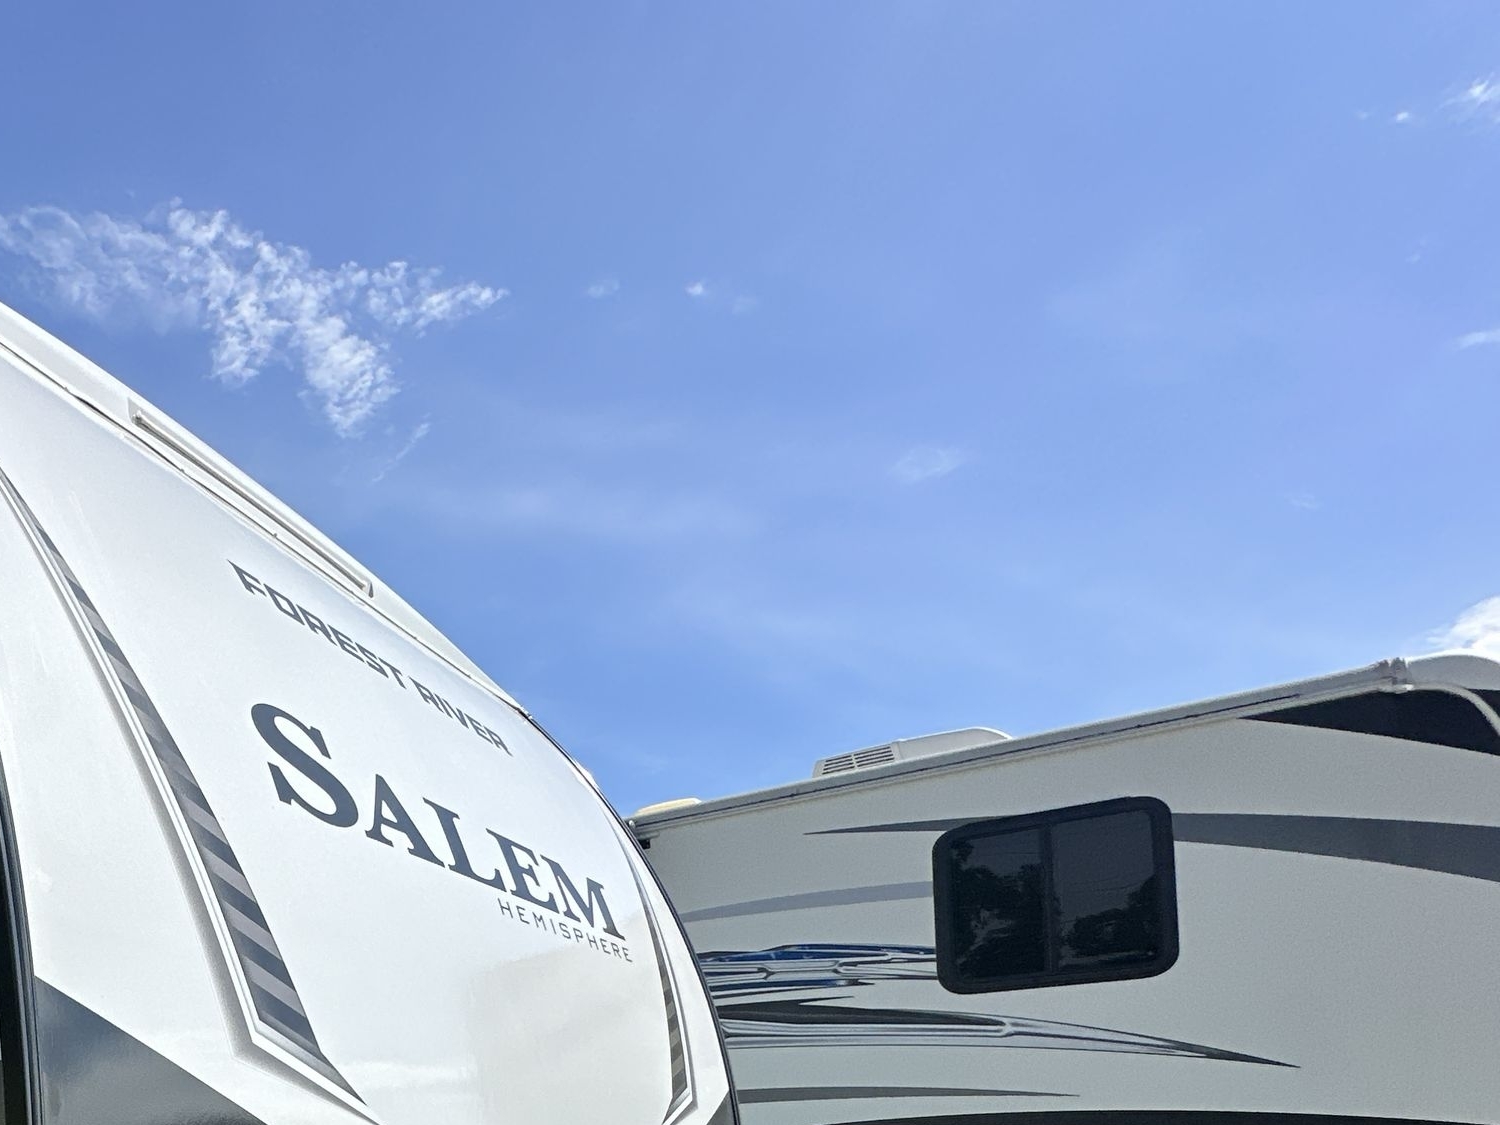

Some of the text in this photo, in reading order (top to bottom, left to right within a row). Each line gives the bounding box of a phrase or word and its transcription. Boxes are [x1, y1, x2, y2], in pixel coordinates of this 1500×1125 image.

[226, 559, 513, 757] FOREST RIVER
[251, 703, 625, 940] SALEM
[497, 897, 633, 963] HEMISPHERE
